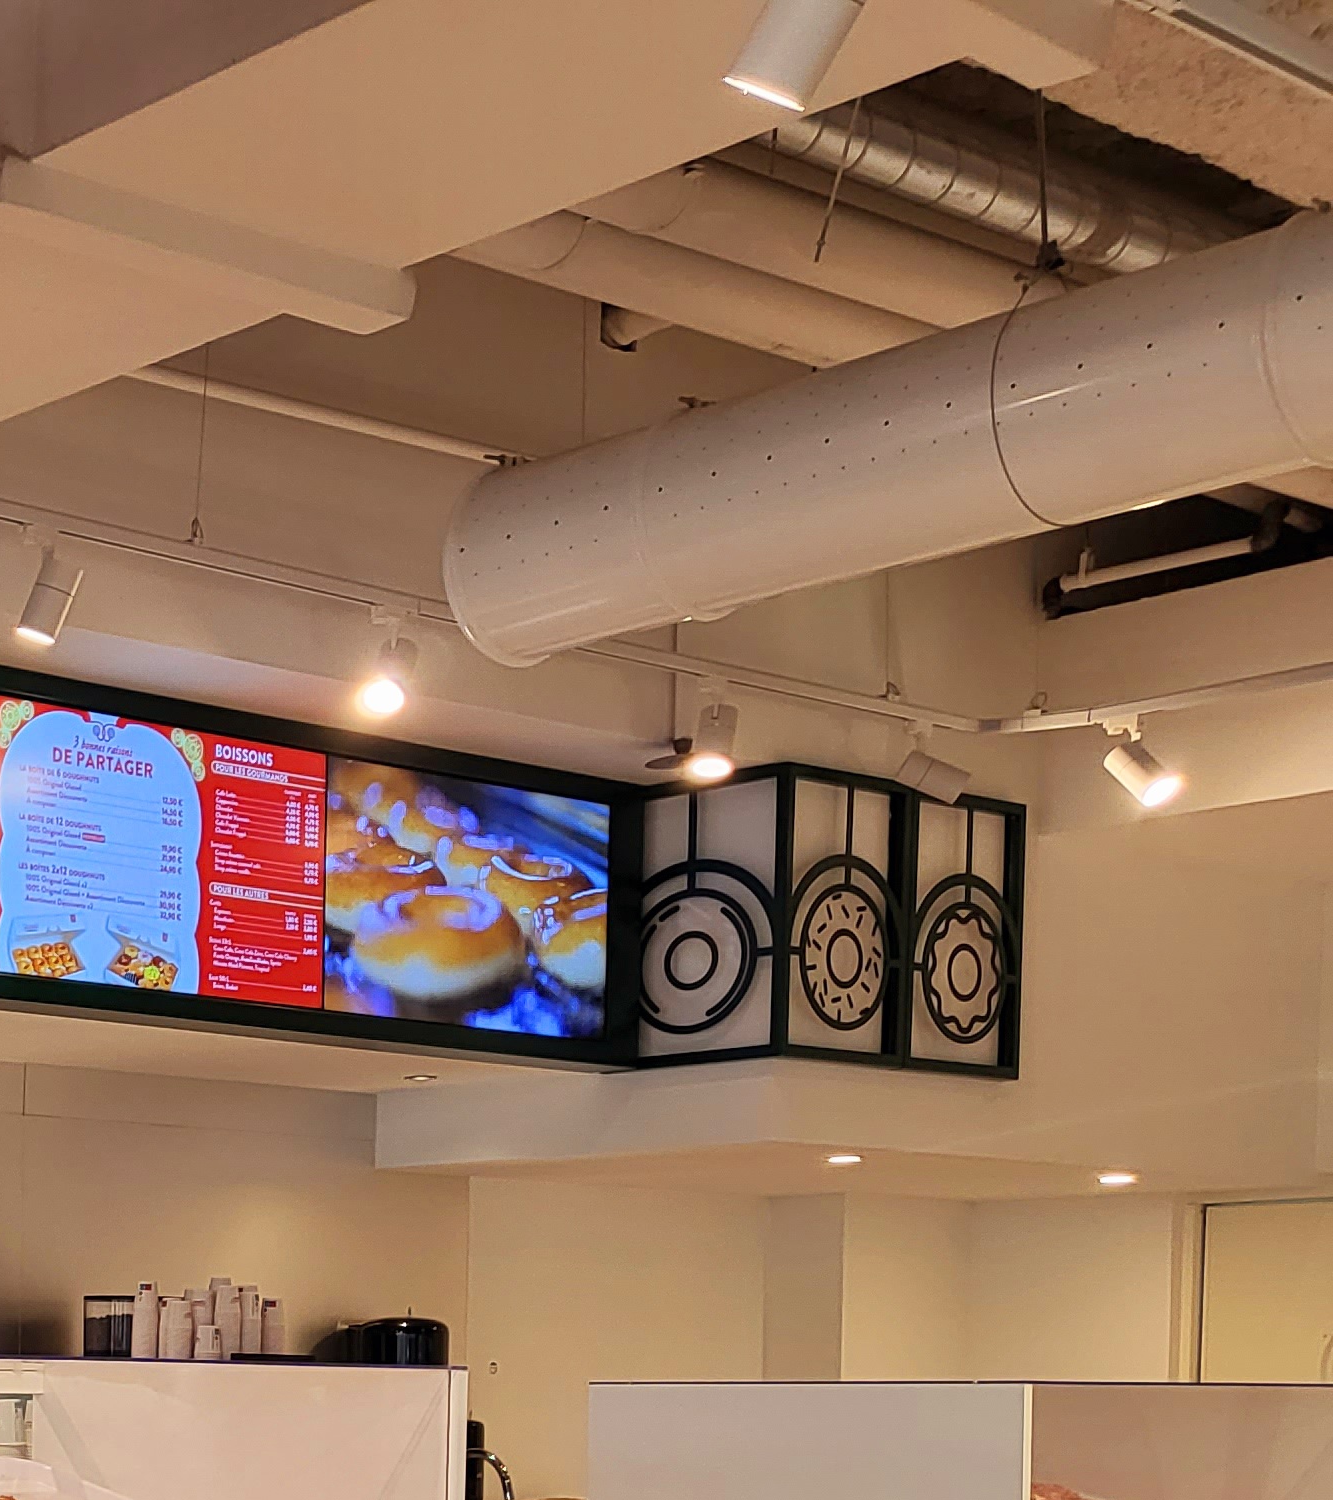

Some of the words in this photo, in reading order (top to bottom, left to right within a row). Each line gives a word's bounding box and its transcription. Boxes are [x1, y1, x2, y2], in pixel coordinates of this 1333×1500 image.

[73, 735, 79, 748] 3
[53, 747, 73, 765] DE
[76, 751, 153, 779] PARTAGER
[215, 744, 273, 767] BOISSONS
[215, 763, 233, 773] POUR
[235, 767, 245, 776] LES
[247, 769, 288, 783] GOURMANDS
[213, 884, 232, 894] POUR
[233, 887, 243, 897] LES
[244, 889, 269, 900] AUTRES
